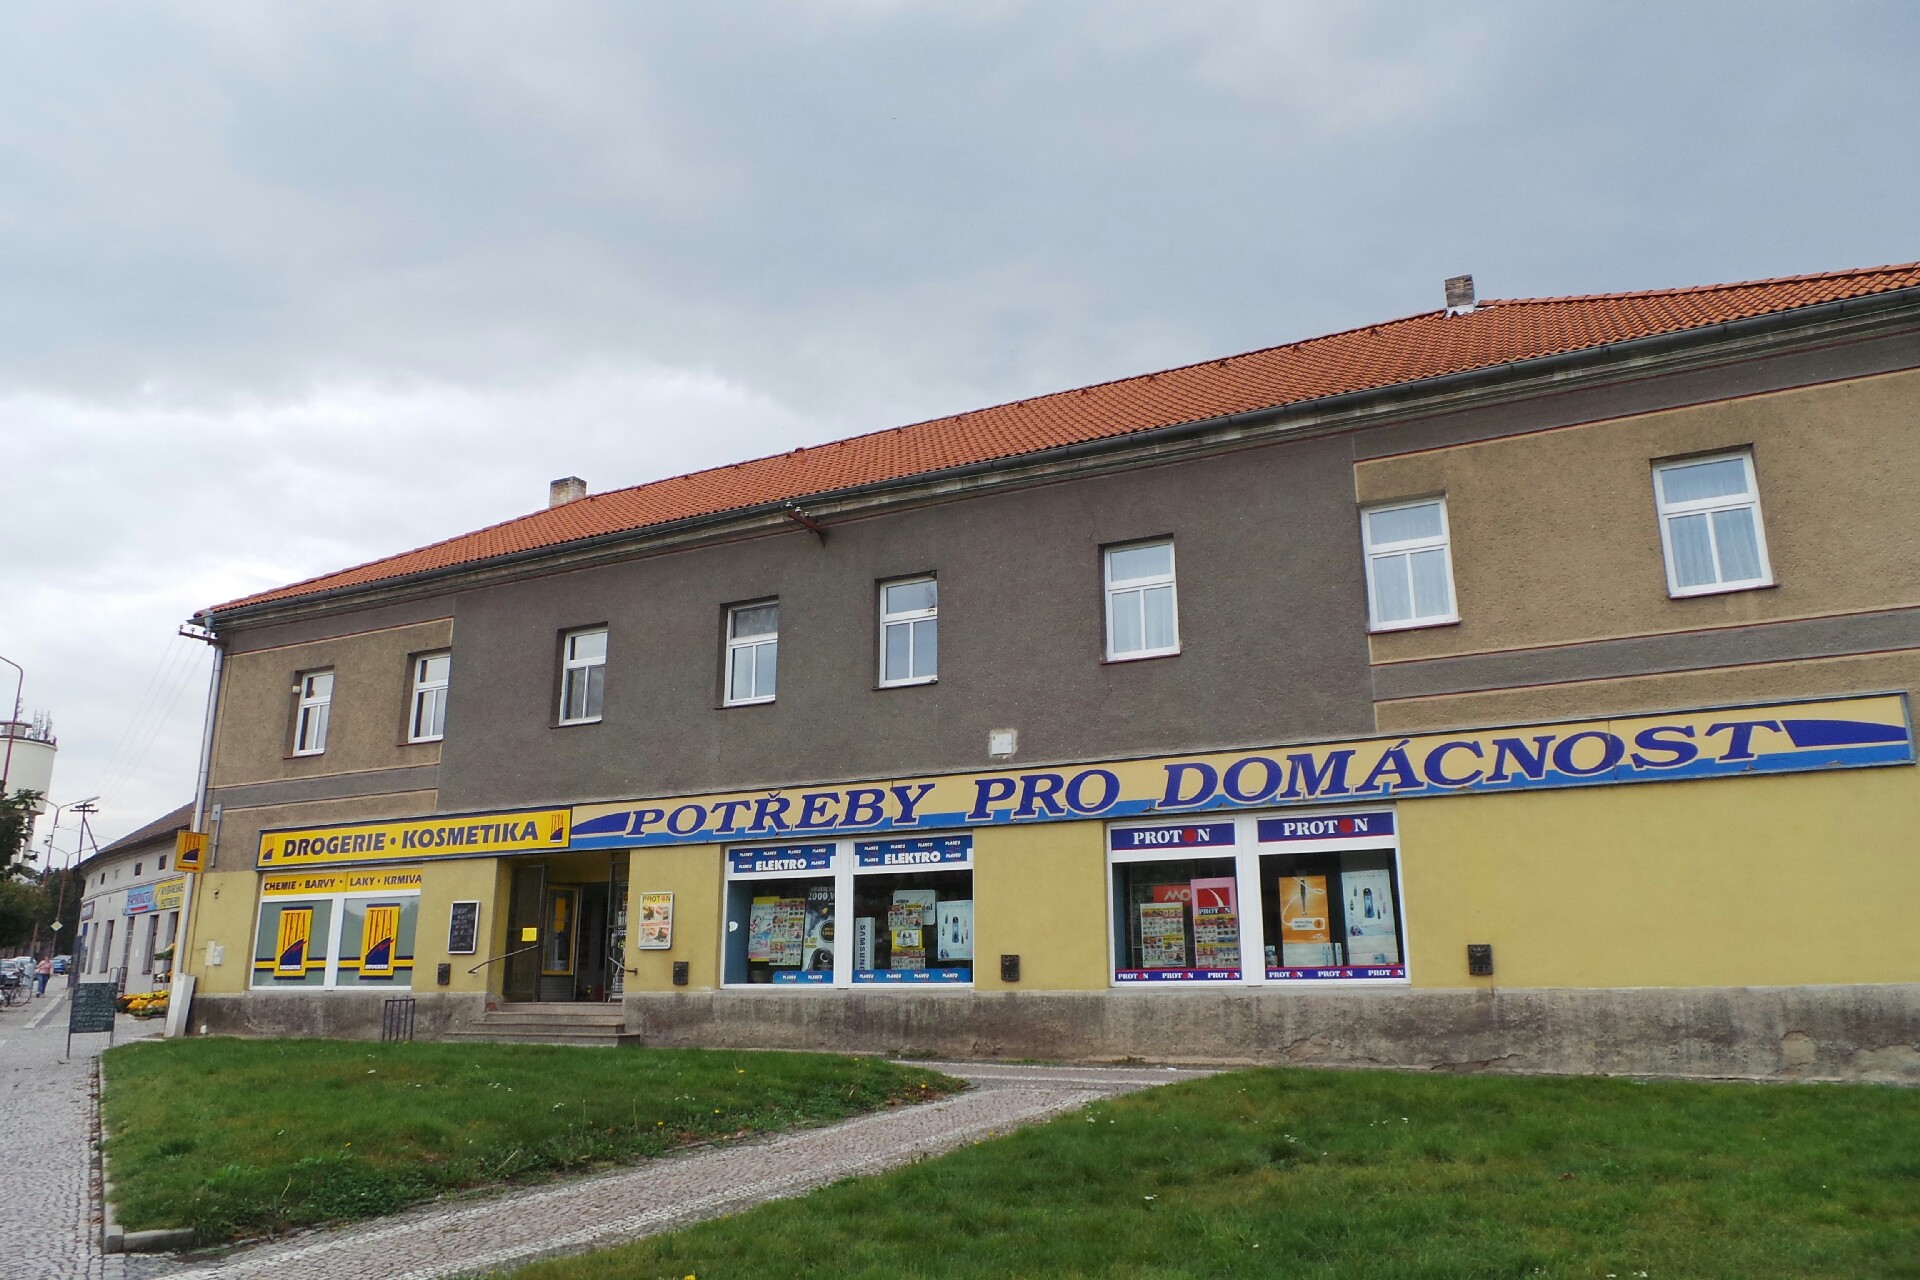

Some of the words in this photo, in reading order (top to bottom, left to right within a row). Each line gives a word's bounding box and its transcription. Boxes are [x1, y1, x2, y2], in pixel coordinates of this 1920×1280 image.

[626, 783, 936, 836] POTŘEBY
[968, 769, 1120, 820] PRO
[1157, 720, 1782, 808] DOMÁCNOST
[282, 832, 386, 857] DROGERIE
[402, 820, 539, 849] KOSMETIKA
[756, 858, 807, 871] ELEKTRO
[884, 851, 941, 865] ELEKTRO
[264, 880, 296, 891] CHEMIE
[304, 878, 335, 889] BARVY
[350, 876, 375, 886] LAKY
[384, 874, 422, 885] KRMIVA
